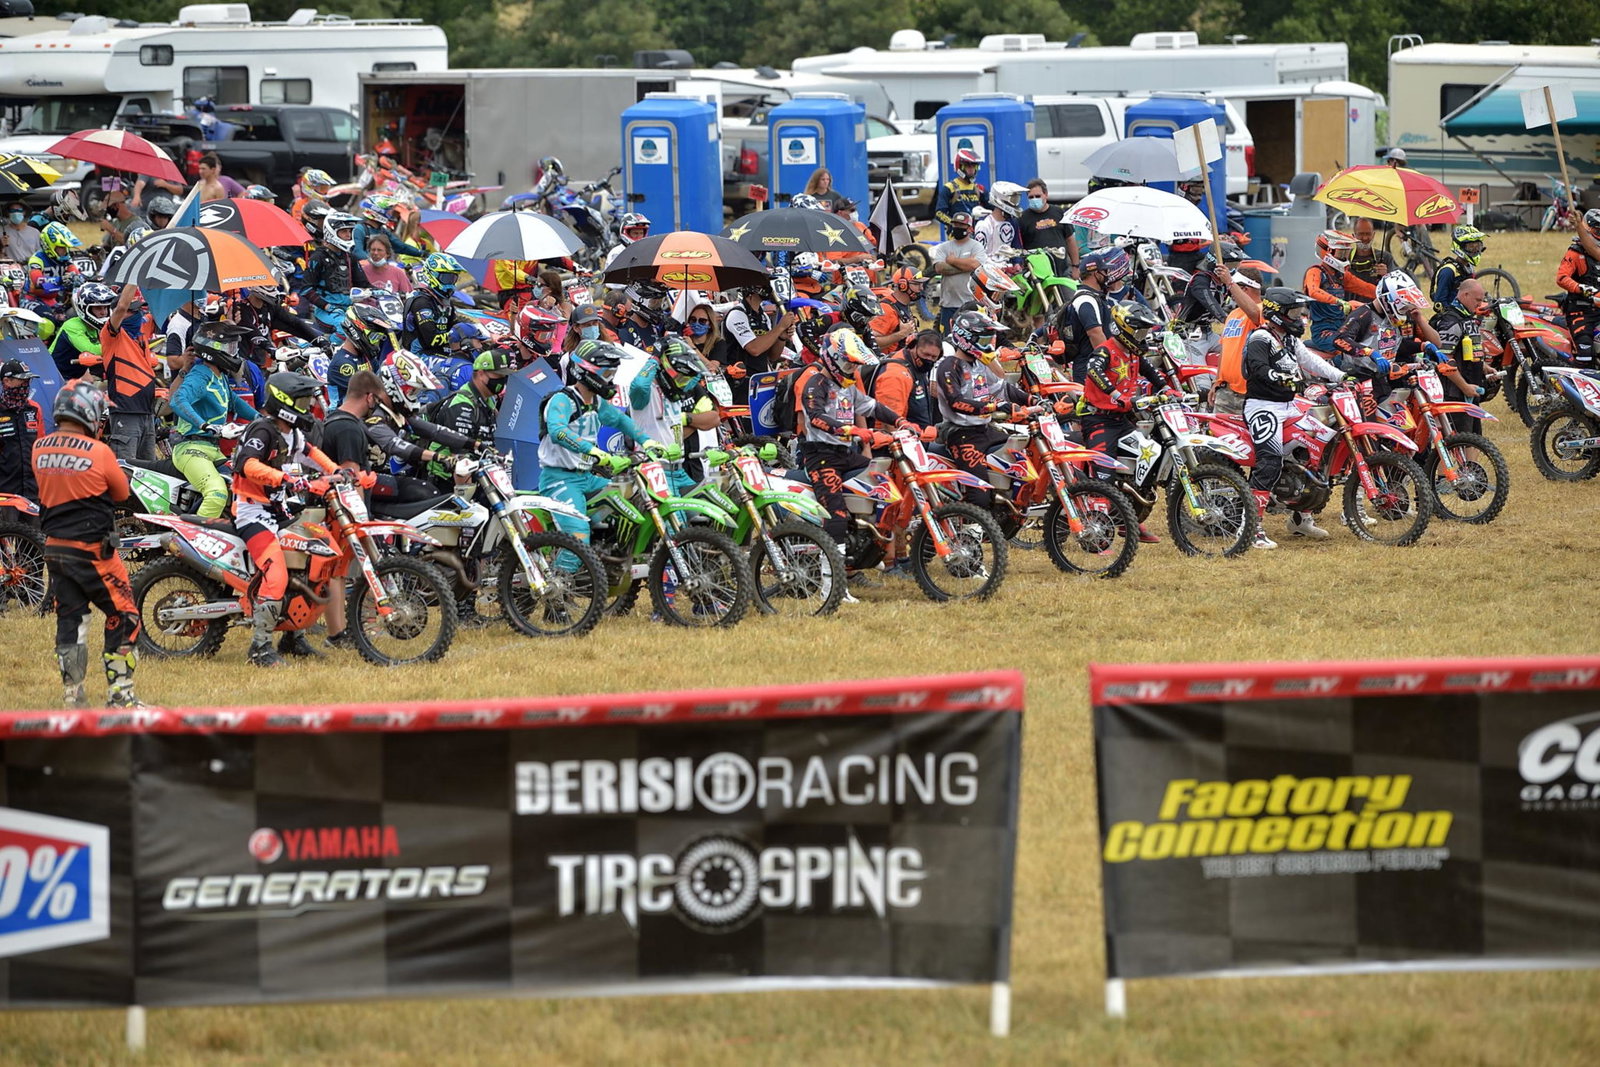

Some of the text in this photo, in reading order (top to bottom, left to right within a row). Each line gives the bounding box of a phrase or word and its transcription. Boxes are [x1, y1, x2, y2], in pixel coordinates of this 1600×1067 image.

[952, 401, 976, 414] KTM
[35, 435, 94, 452] BOLTON
[914, 443, 926, 466] 1
[1298, 436, 1320, 452] HONDA
[36, 453, 93, 472] GNCC
[279, 537, 308, 551] AXXIS
[515, 758, 693, 815] DERISI
[757, 752, 980, 808] RACING
[1159, 774, 1413, 820] Factory
[282, 825, 400, 861] YAMAHA
[162, 865, 490, 911] GENERATORS
[548, 826, 932, 938] TIRE SPINE
